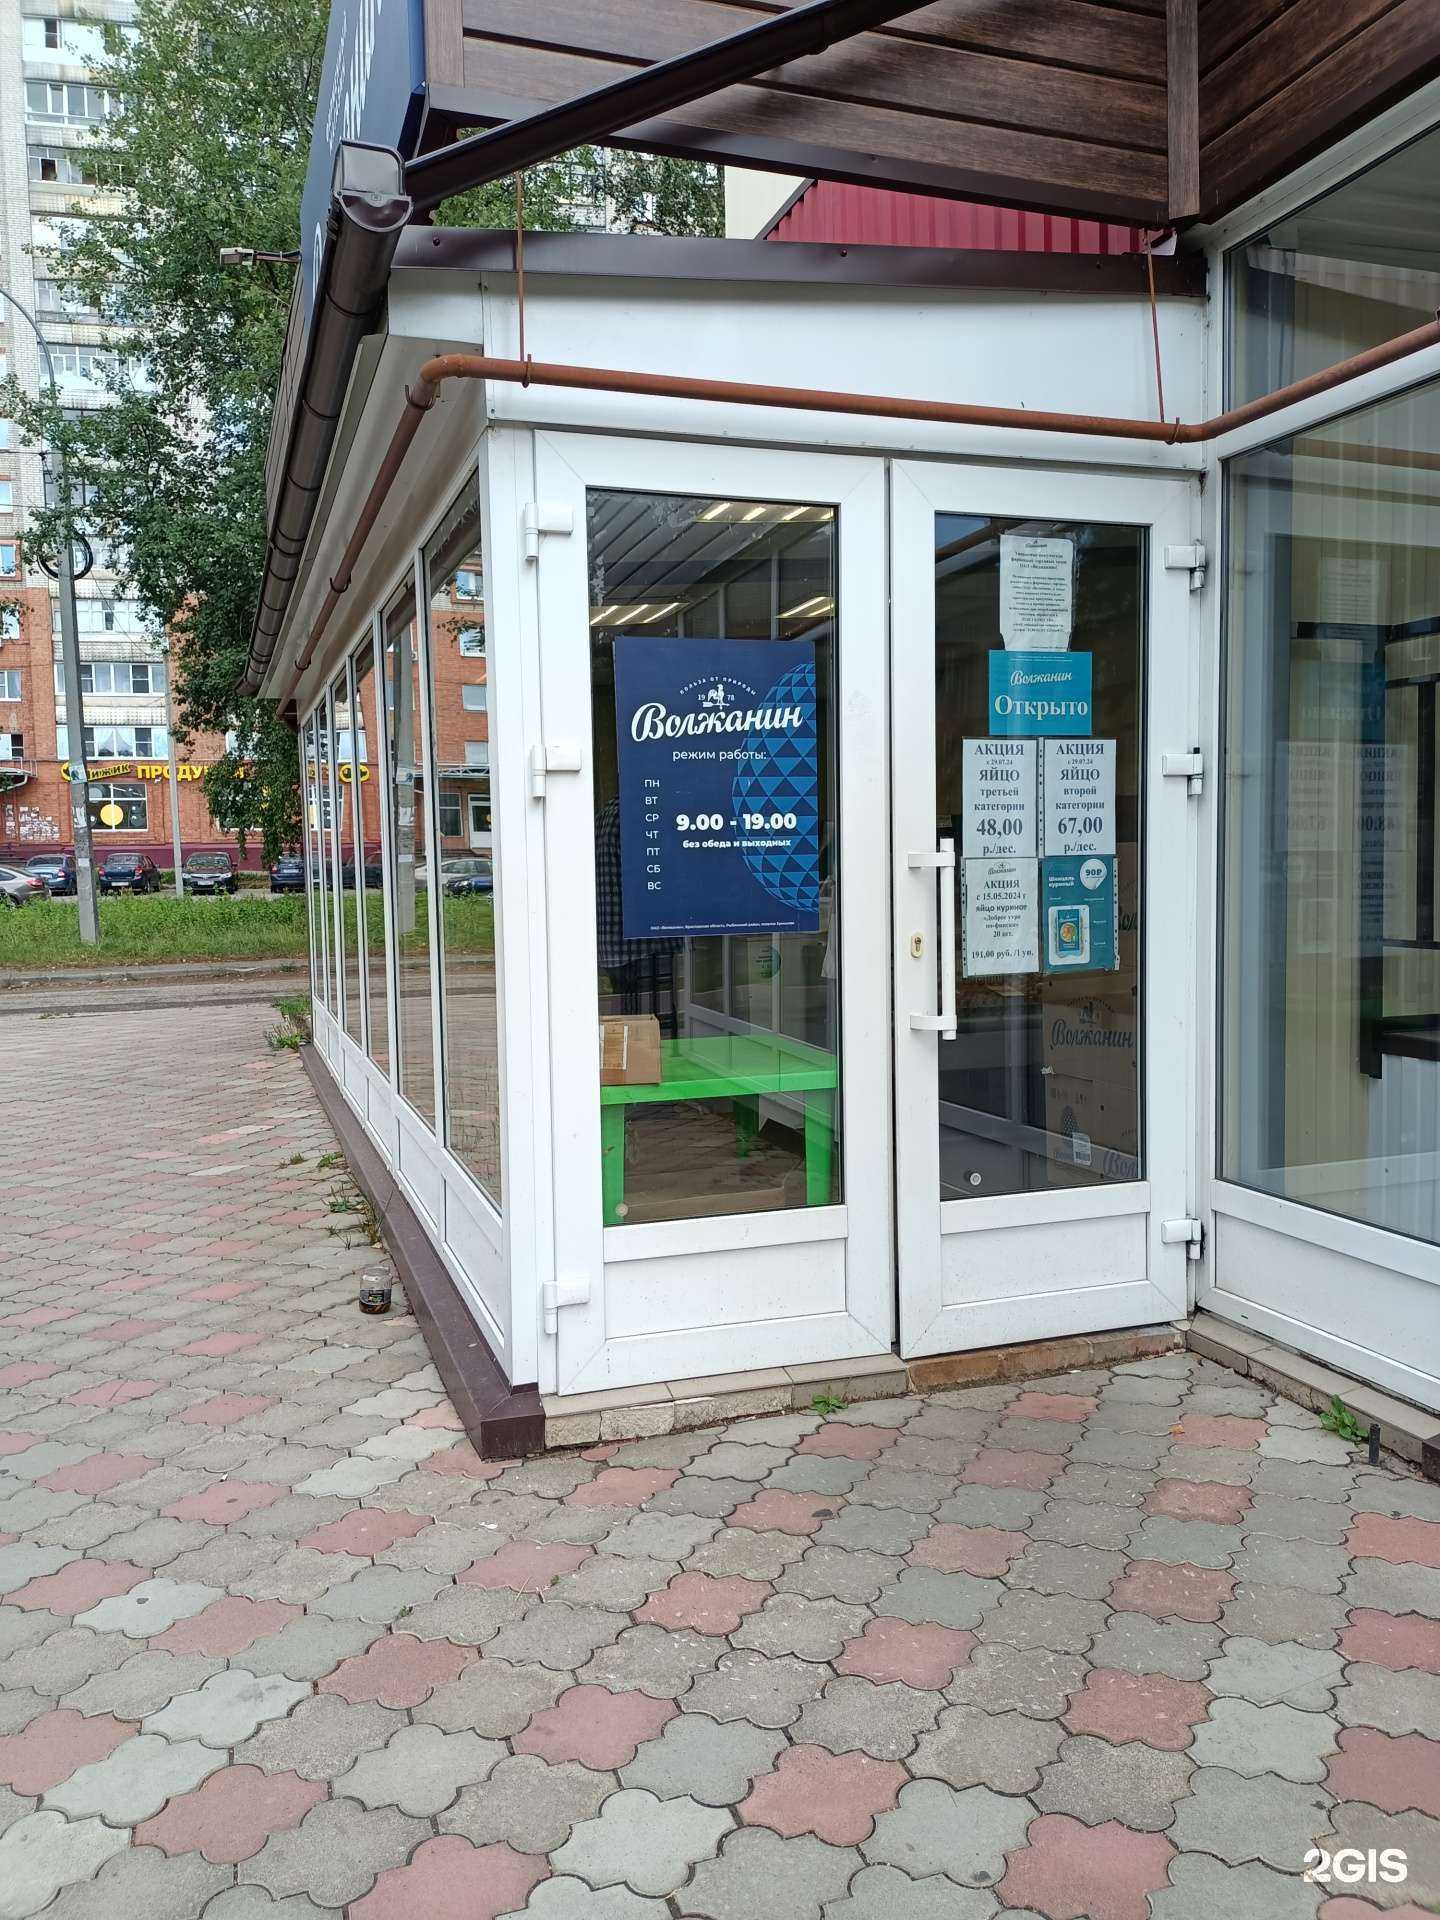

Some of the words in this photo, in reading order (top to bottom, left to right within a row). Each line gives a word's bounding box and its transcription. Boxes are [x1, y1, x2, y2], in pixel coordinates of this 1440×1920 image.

[1010, 670, 1073, 686] Волжанин
[994, 694, 1088, 721] Открыто
[631, 702, 803, 742] Волжанин
[974, 743, 1025, 757] АКЦИЯ
[1055, 743, 1105, 756] АКЦИЯ
[672, 751, 716, 762] режим
[719, 749, 767, 762] работы:
[979, 767, 1020, 782] ЯЙЦО
[1060, 766, 1100, 782] ЯЙЦО
[644, 779, 660, 788] ПН
[980, 788, 1019, 798] третьей
[1063, 786, 1097, 797] второй
[645, 796, 658, 805] ВТ
[974, 803, 1025, 813] категории
[1055, 801, 1105, 812] категории
[645, 813, 659, 822] СР
[676, 813, 724, 831] 9.00
[742, 812, 797, 830] 19.00
[976, 818, 1023, 839] 48,00
[1057, 816, 1103, 837] 67,00
[645, 830, 659, 839] ЧТ
[682, 839, 700, 848] без
[702, 839, 731, 848] обеда
[742, 839, 791, 847] выходных
[1064, 841, 1097, 854] р./дес.
[646, 847, 660, 856] ПТ
[983, 843, 1016, 856] р./дес.
[646, 864, 661, 873] СБ
[647, 881, 662, 890] ВС
[984, 880, 1020, 890] АКЦИЯ
[983, 892, 1020, 900] 15.05.2024
[972, 950, 995, 959] 191,00
[1051, 1019, 1134, 1048] Волжанин
